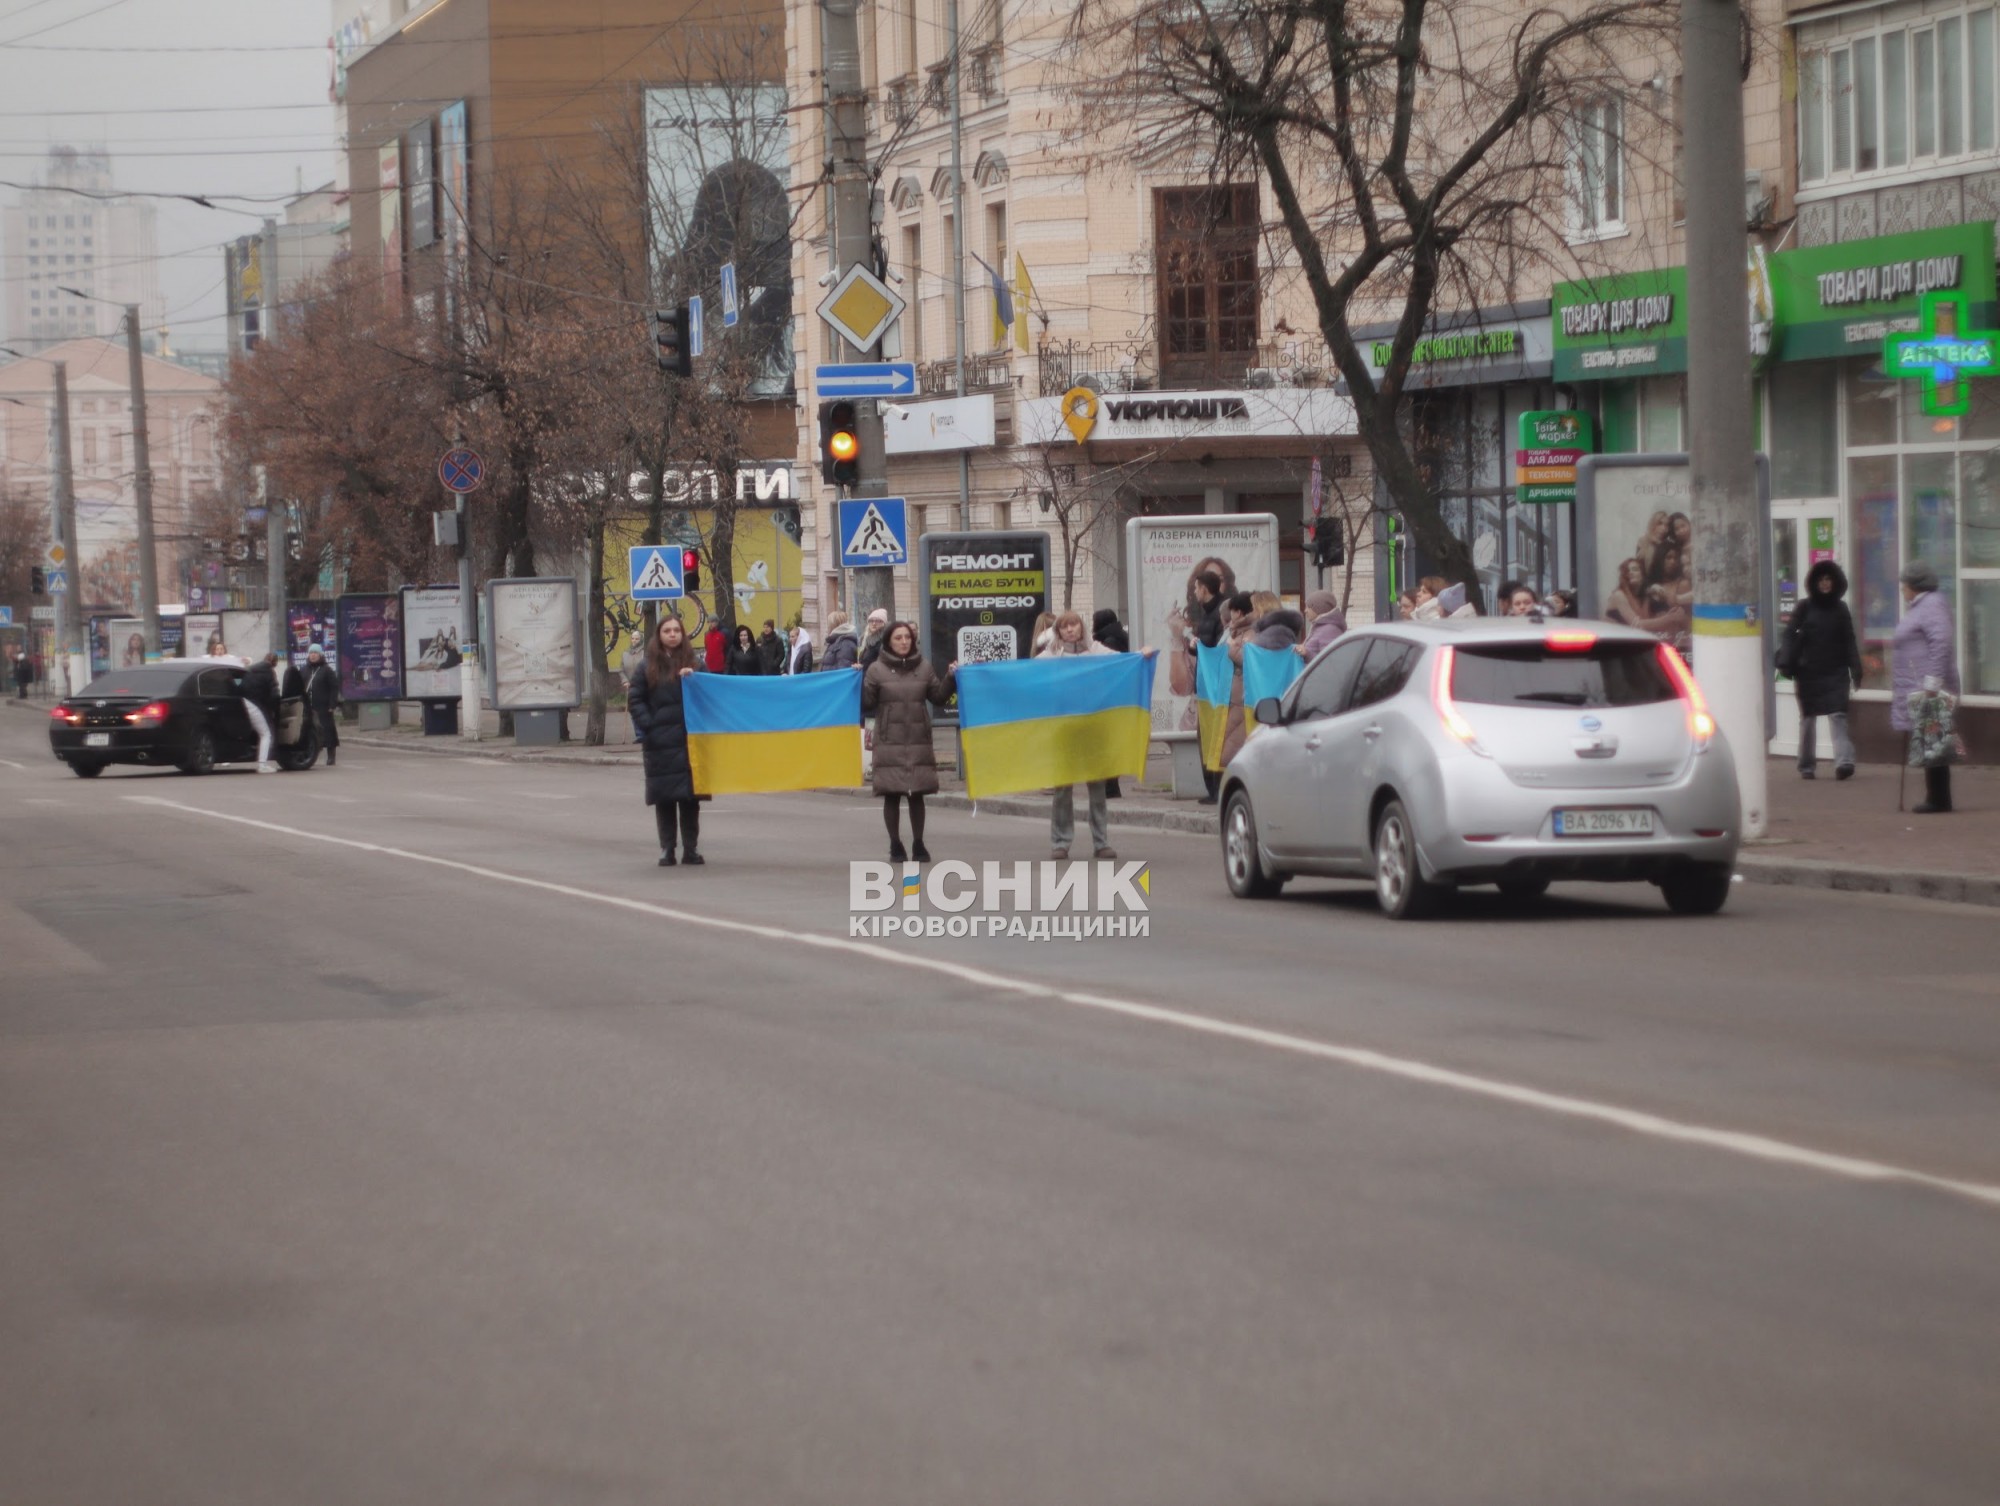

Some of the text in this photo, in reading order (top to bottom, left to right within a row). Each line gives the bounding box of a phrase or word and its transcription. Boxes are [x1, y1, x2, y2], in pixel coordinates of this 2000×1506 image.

[1817, 255, 1959, 305] ТОВАРИ ДЛЯ ДОМУ
[1561, 295, 1671, 334] ТОВАРИ ДЛЯ ДОМУ
[1901, 344, 1991, 363] АПТЕКА
[1105, 397, 1250, 421] УКРПОШТА
[1107, 424, 1159, 435] ГОЛОВНА
[1533, 421, 1557, 433] Твій
[1538, 432, 1578, 444] маркет
[1528, 455, 1574, 466] ДЛЯ ДОМУ
[1529, 470, 1573, 480] ТЕКСТИЛЬ
[1149, 529, 1260, 540] ЛАЗЕРНА ЕПІЛЯЦІЯ
[936, 553, 1034, 570] РЕМОНТ
[1143, 555, 1193, 564] LASEROSE
[937, 577, 1035, 589] НЕ МАЄ БУТИ
[937, 596, 1035, 609] ЛОТЕРЕЄЮ
[1564, 813, 1649, 829] BA 2096 YA
